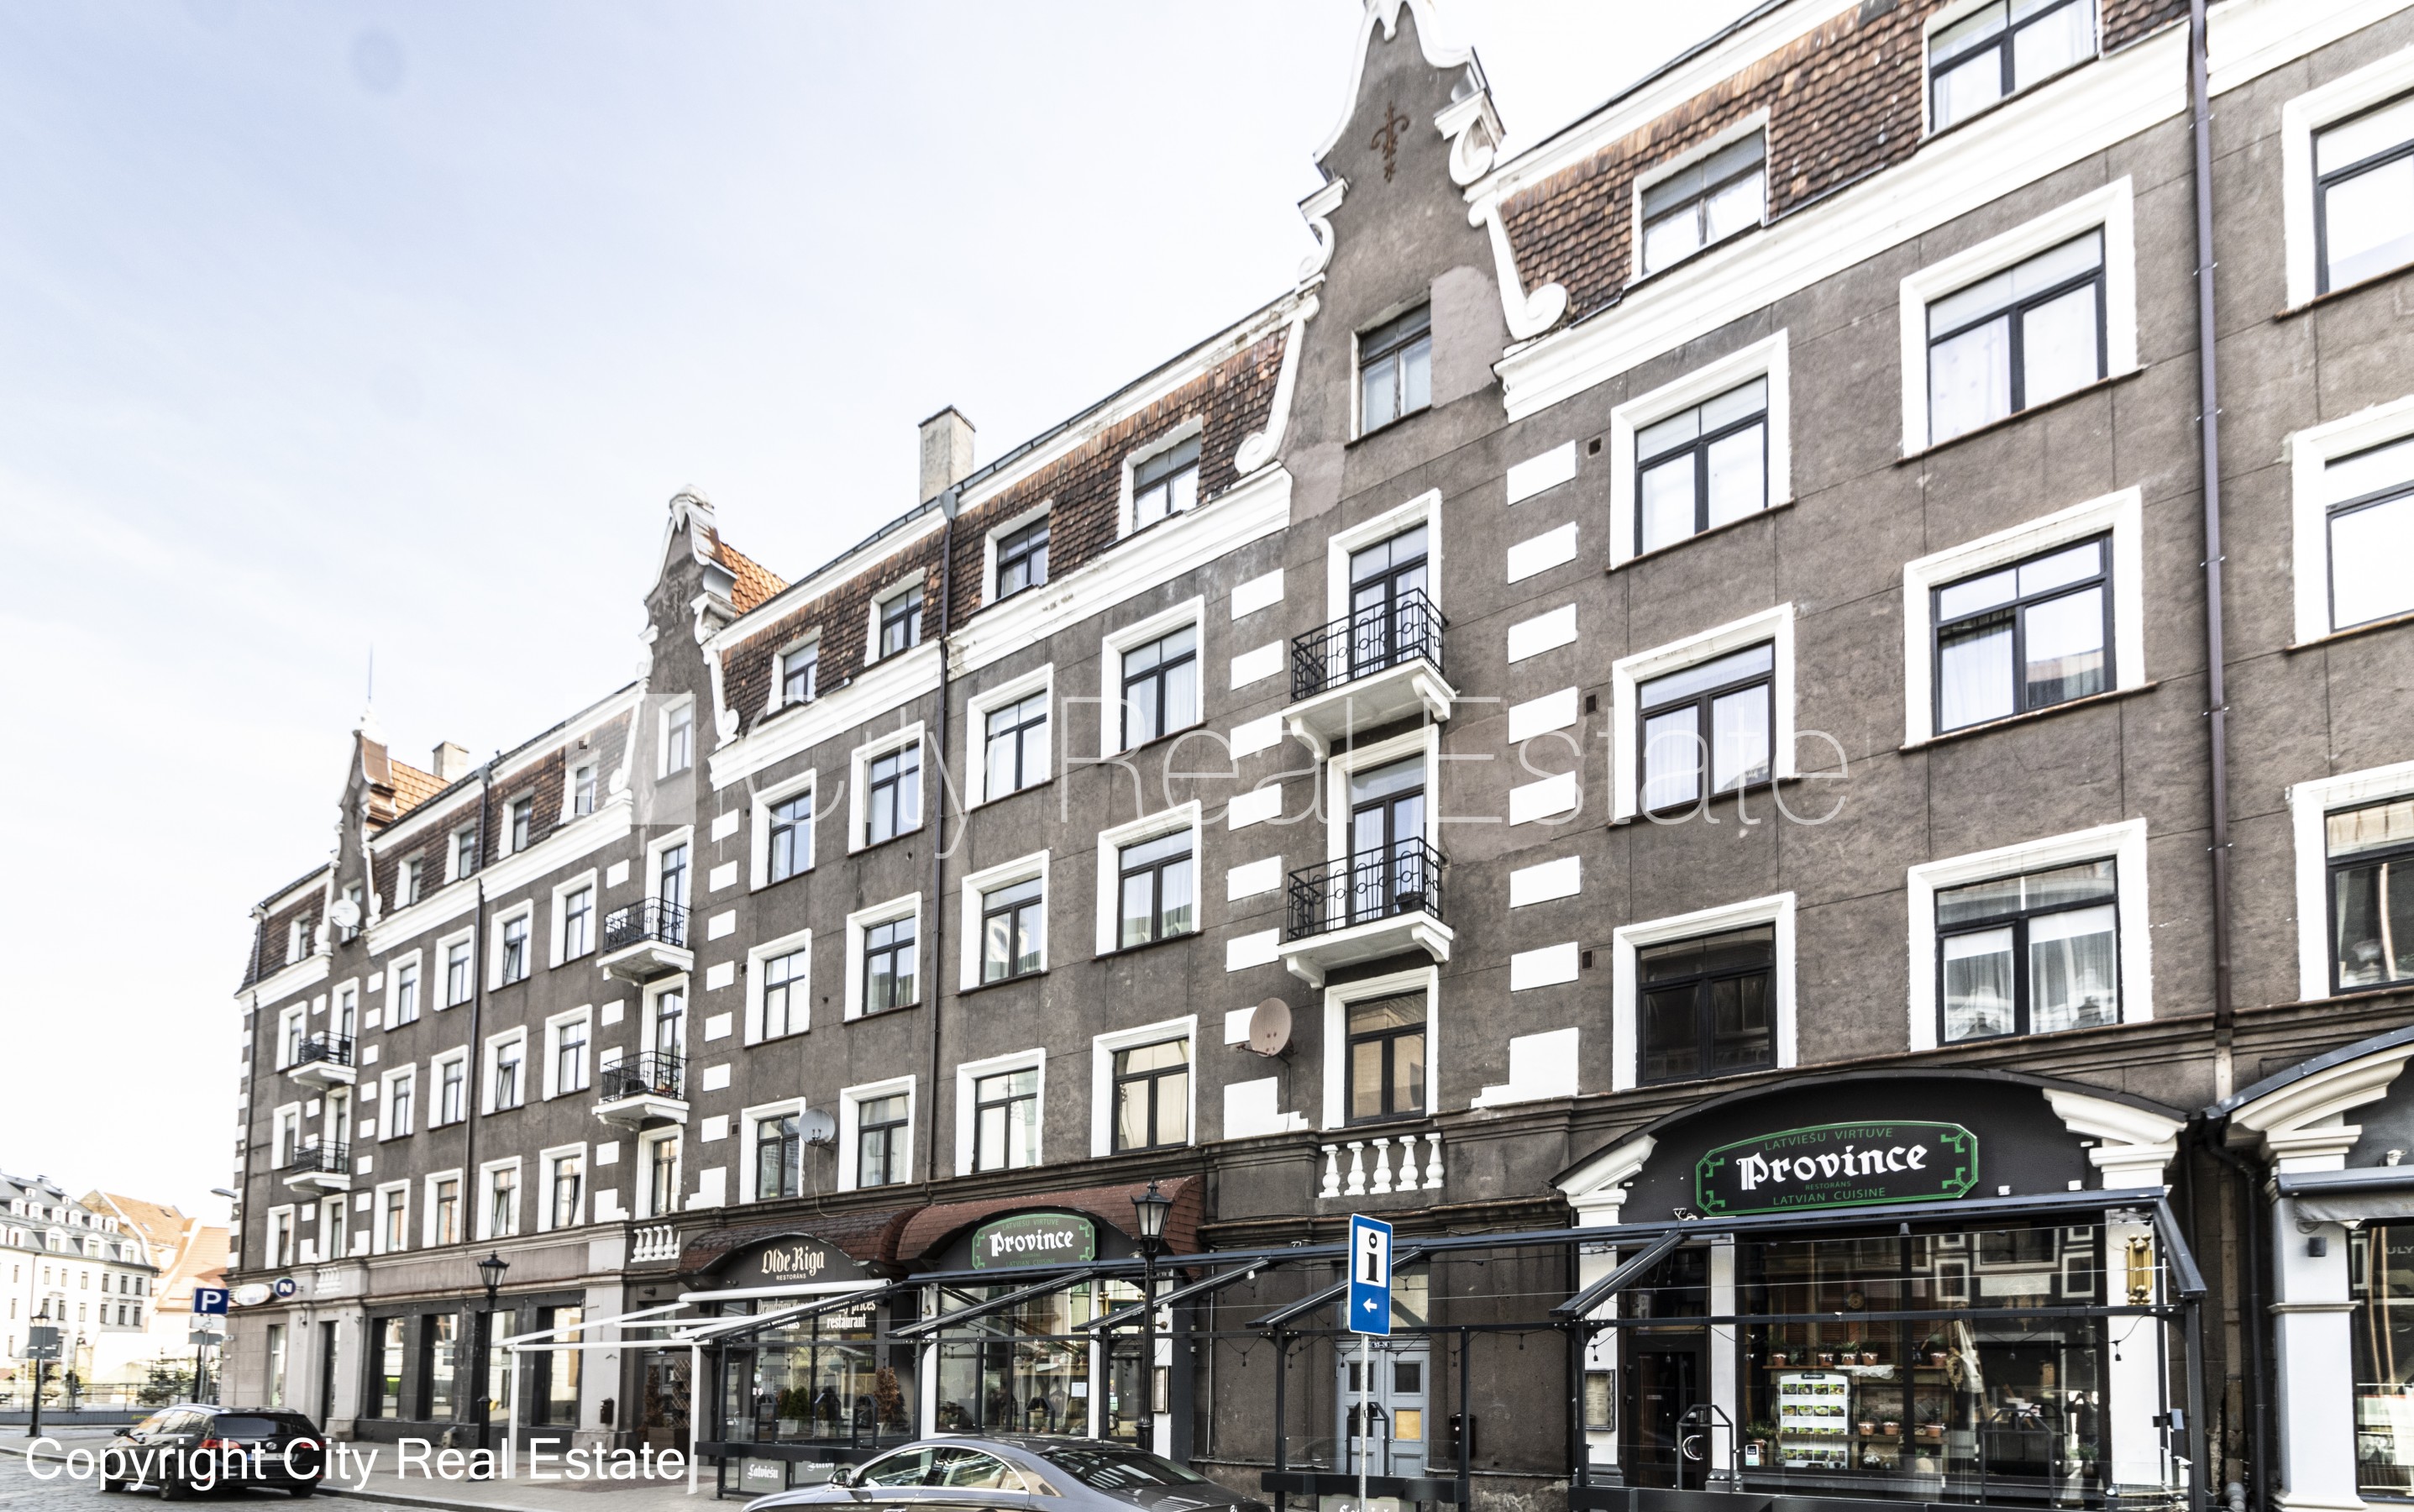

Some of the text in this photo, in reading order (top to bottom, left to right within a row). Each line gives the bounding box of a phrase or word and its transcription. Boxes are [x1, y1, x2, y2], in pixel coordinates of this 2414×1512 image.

[1765, 1128, 1893, 1151] LATVIEŠU VIRTUVE
[1736, 1144, 1928, 1191] Province
[1772, 1188, 1886, 1205] LATVIAN CUISINE
[989, 1229, 1074, 1257] Province
[761, 1246, 825, 1277] Olde Riga
[280, 1283, 292, 1293] N
[201, 1290, 222, 1311] P
[827, 1313, 866, 1329] restaurant
